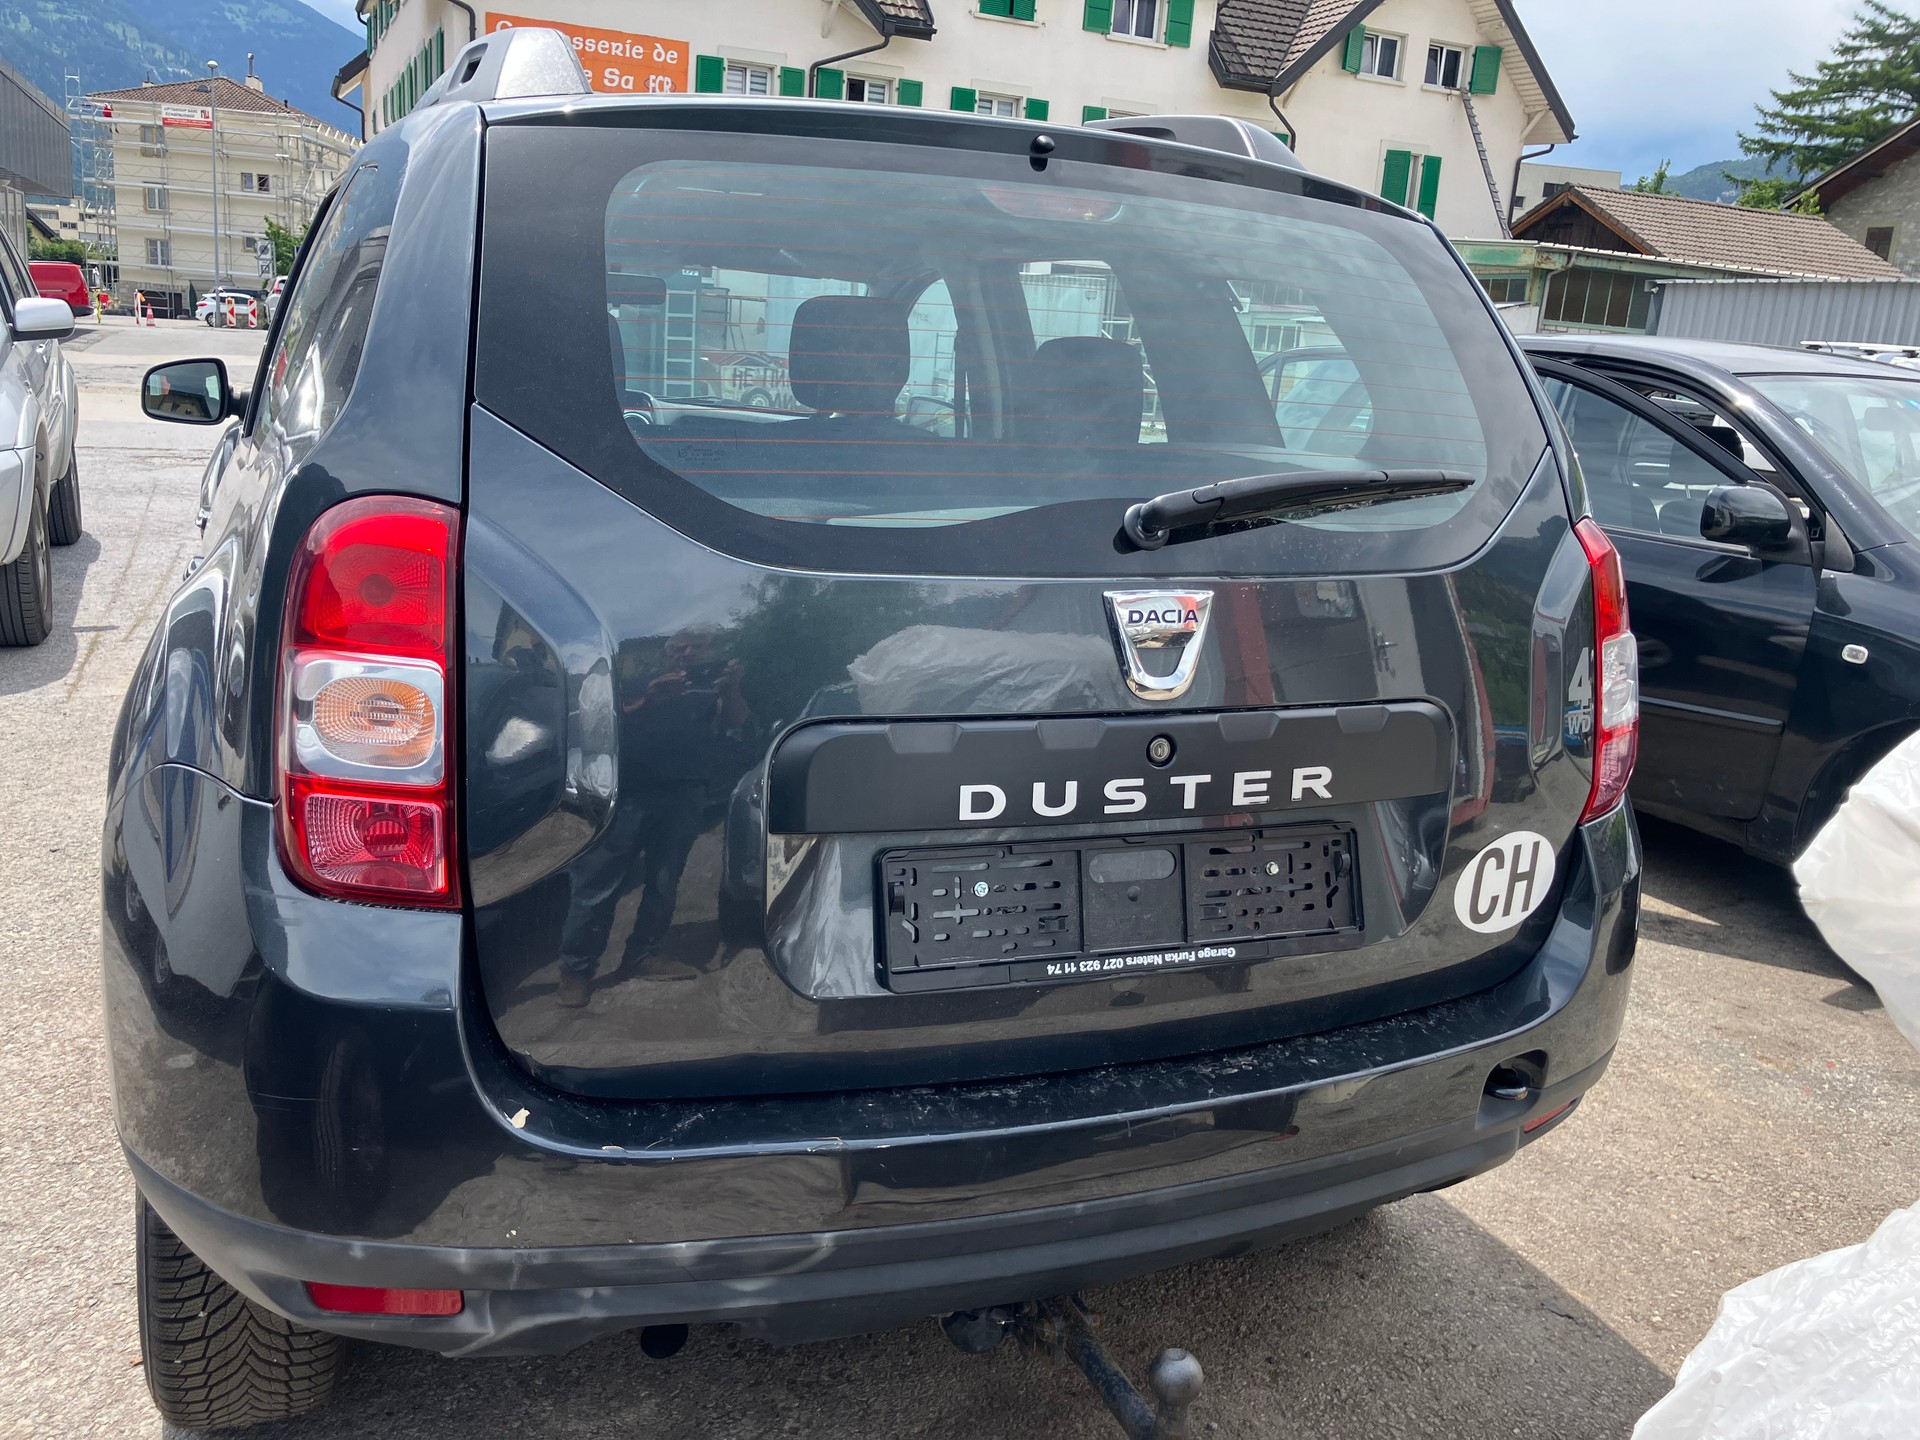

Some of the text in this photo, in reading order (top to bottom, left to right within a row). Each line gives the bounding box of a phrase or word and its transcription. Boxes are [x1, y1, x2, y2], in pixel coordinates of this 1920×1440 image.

[653, 43, 678, 64] de
[604, 68, 633, 89] Sa
[1128, 609, 1198, 623] DACIA
[1568, 647, 1592, 709] 4
[959, 765, 1333, 821] DUSTER
[1469, 840, 1541, 925] CH
[1046, 946, 1236, 975] Garage Furka Naters 027 923 11 74
